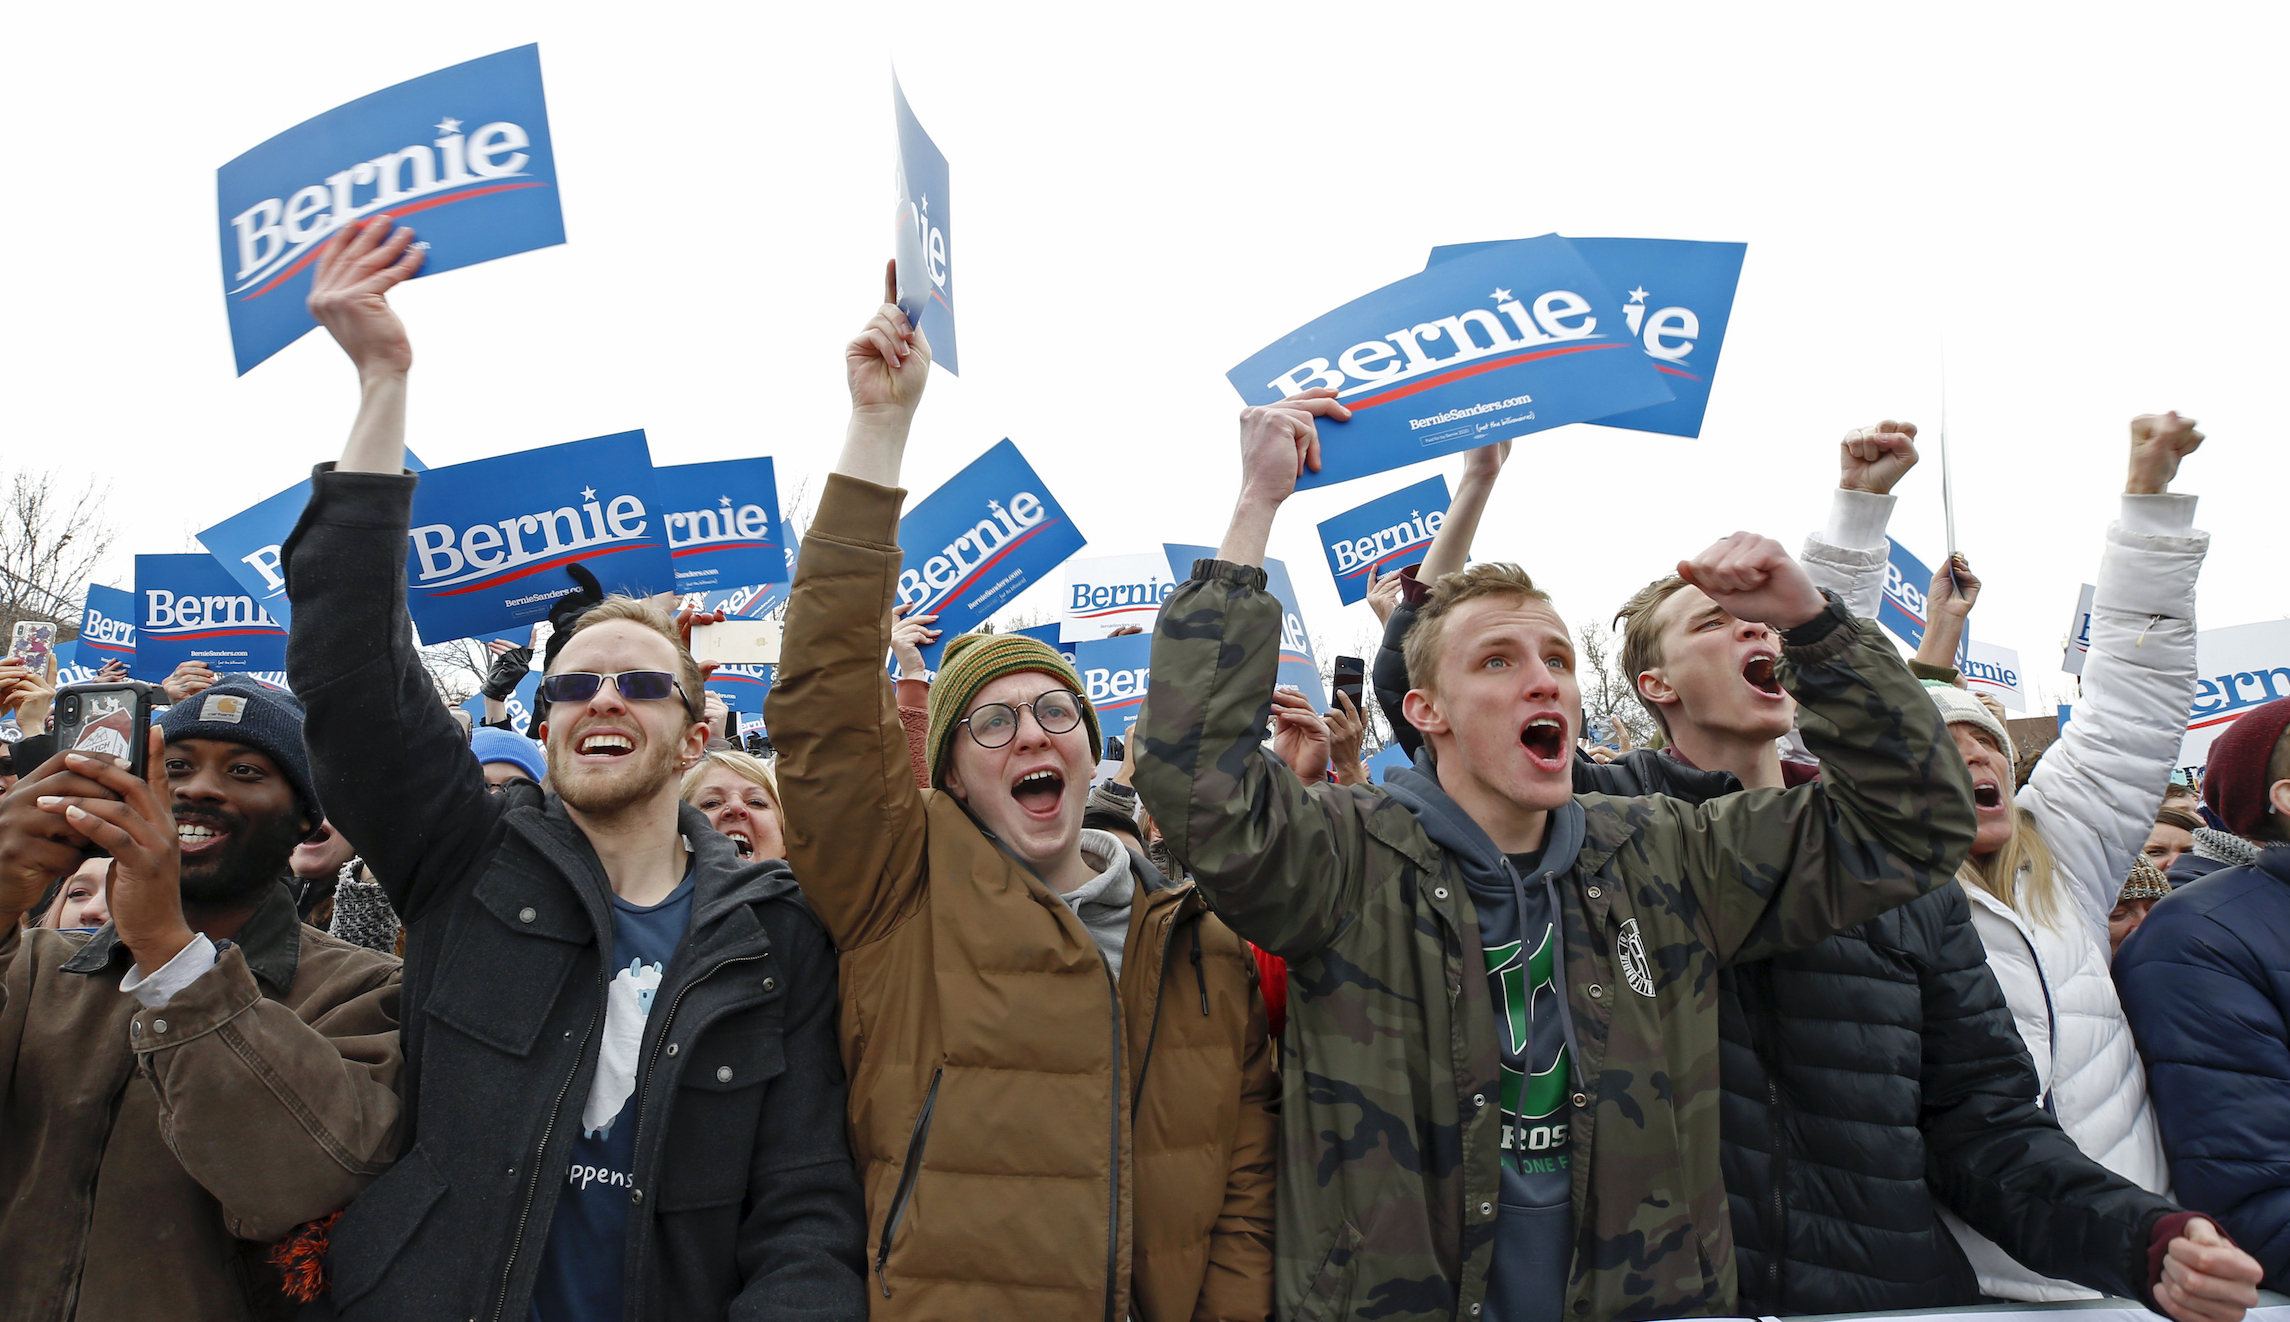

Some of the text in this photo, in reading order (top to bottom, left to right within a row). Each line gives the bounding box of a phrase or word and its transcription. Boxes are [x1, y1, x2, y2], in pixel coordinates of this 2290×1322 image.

[231, 116, 530, 281] Bernie
[1267, 286, 1597, 401] Bernie
[1409, 394, 1533, 430] BernieSanders.com
[409, 485, 648, 581] Bernie
[663, 494, 768, 545] rnie
[897, 491, 1045, 615] Bernie
[1331, 509, 1446, 572] Bernie
[146, 590, 272, 627] Berni
[967, 567, 1023, 610] BernieSanders.com
[1070, 576, 1177, 609] Bernie
[84, 609, 136, 645] Bern
[1084, 667, 1150, 699] Ber
[1966, 660, 2017, 686] rnie
[2190, 667, 2290, 712] ern
[1501, 1125, 1569, 1150] ROS
[567, 1164, 634, 1190] ppens
